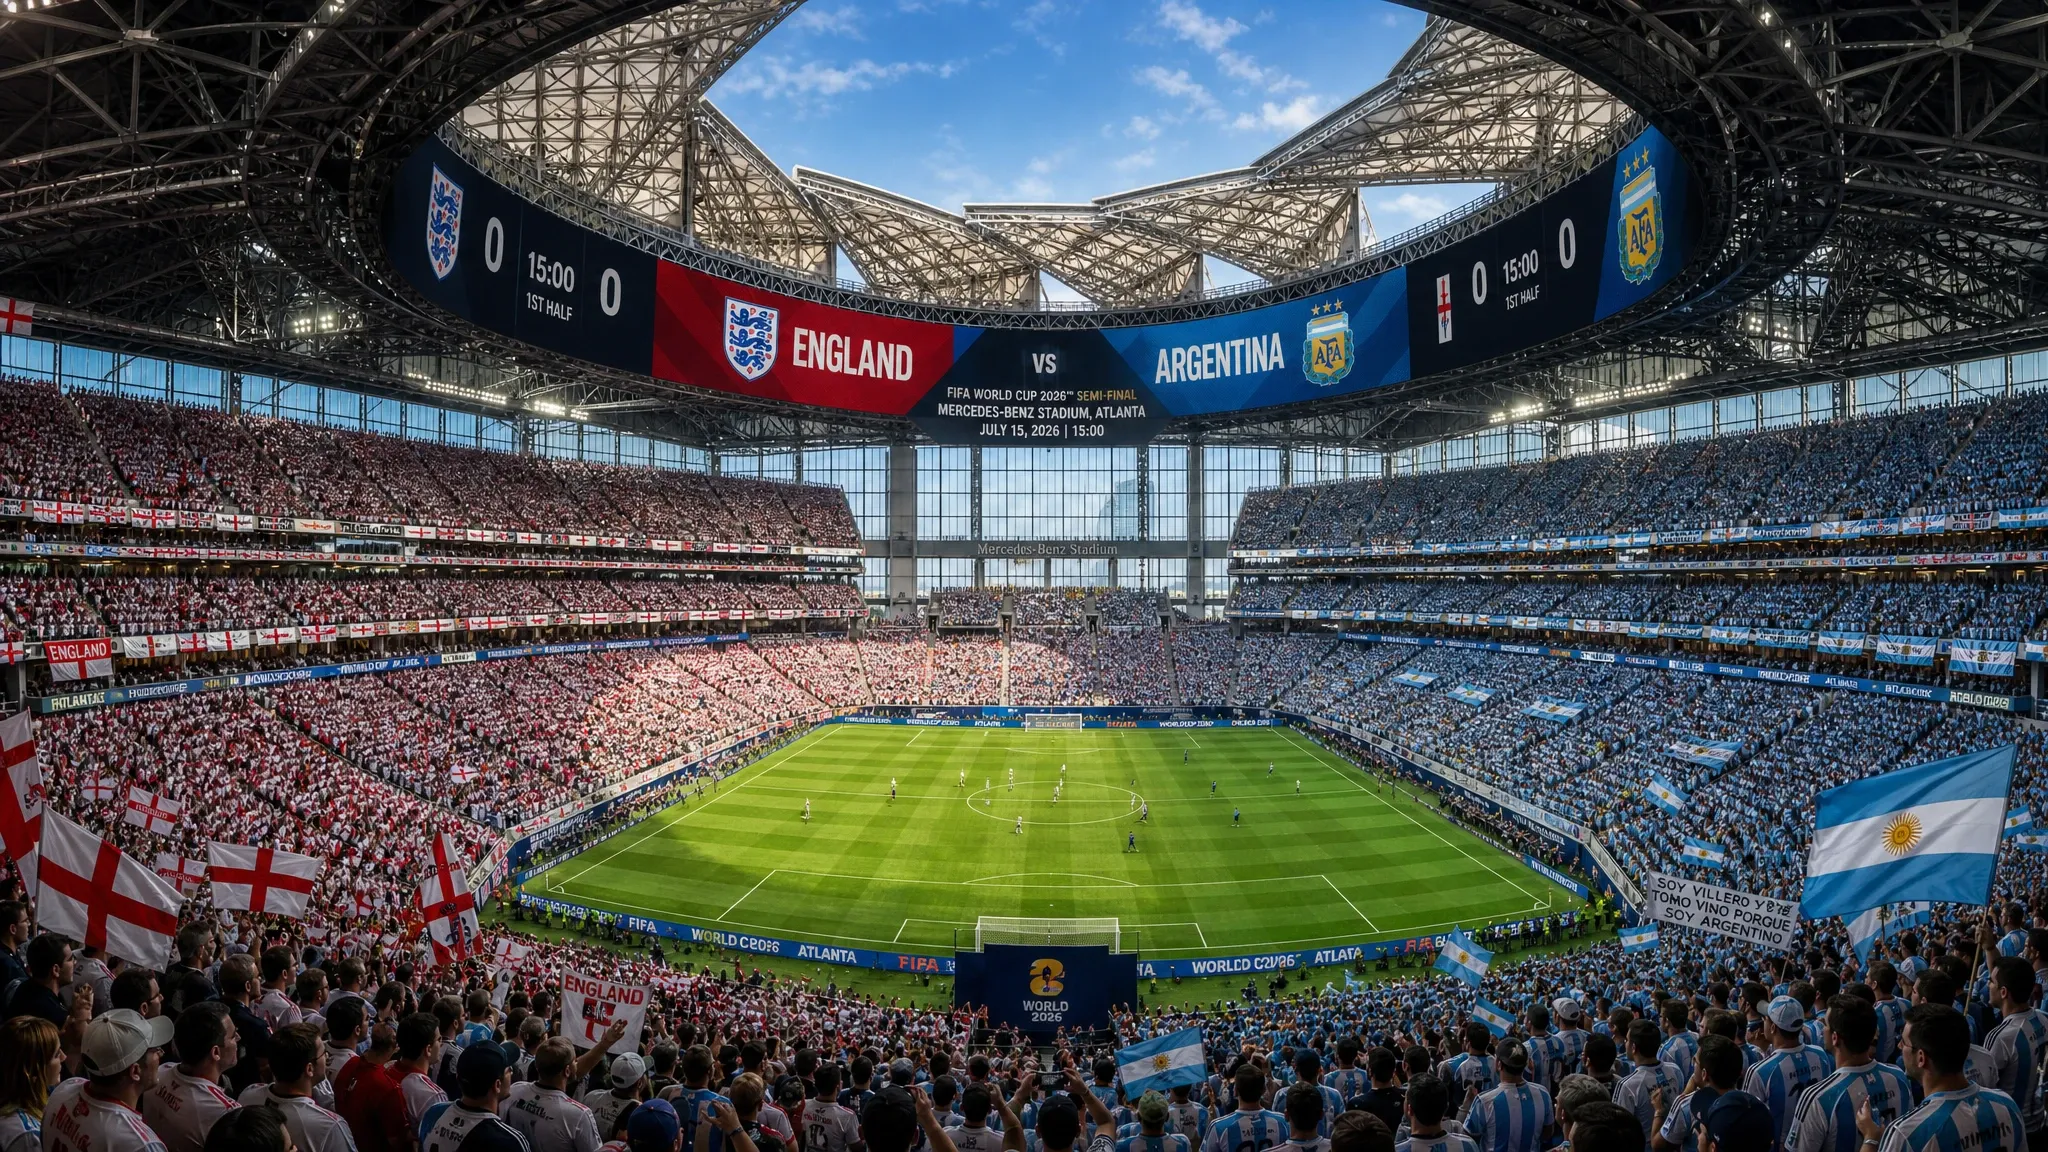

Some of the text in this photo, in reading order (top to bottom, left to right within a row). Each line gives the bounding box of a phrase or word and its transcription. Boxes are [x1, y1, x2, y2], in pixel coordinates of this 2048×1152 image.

[485, 217, 504, 273] 0
[1559, 218, 1576, 269] 0
[528, 251, 575, 293] 15:00
[1503, 249, 1539, 284] 15:00
[600, 268, 622, 317] 0
[1472, 261, 1487, 305] 0
[527, 292, 573, 321] 1ST HALF
[1506, 284, 1540, 310] 1ST HALF
[793, 327, 913, 381] ENGLAND
[1032, 353, 1056, 374] VS
[1155, 332, 1285, 384] ARGENTINA
[947, 386, 970, 400] FIFA
[973, 388, 1012, 401] WORLD
[1015, 390, 1037, 402] CUP
[1076, 388, 1137, 401] SEMI-FINAL
[938, 402, 1146, 421] MERCEDES-BENZ STADIUM, ATLANTA
[979, 423, 1105, 438] JULY 15, 2026 15:00
[977, 543, 1118, 555] Mercedes-Benz Stadium
[50, 642, 107, 661] ENGLAND
[1657, 877, 1686, 893] SOY
[1693, 885, 1750, 908] VILLERO
[1651, 889, 1691, 909] TOMO
[1696, 899, 1729, 917] VINO
[1734, 908, 1791, 933] PORGUE
[629, 917, 658, 934] FIFA
[691, 928, 738, 946] WORLD
[1664, 907, 1783, 945] SOY ARGENTINO
[797, 944, 857, 964] ATLANTA
[898, 956, 939, 972] FIFA
[564, 974, 644, 1005] ENGLAND
[1023, 1000, 1069, 1012] WORLD
[1031, 1012, 1063, 1022] 2026
